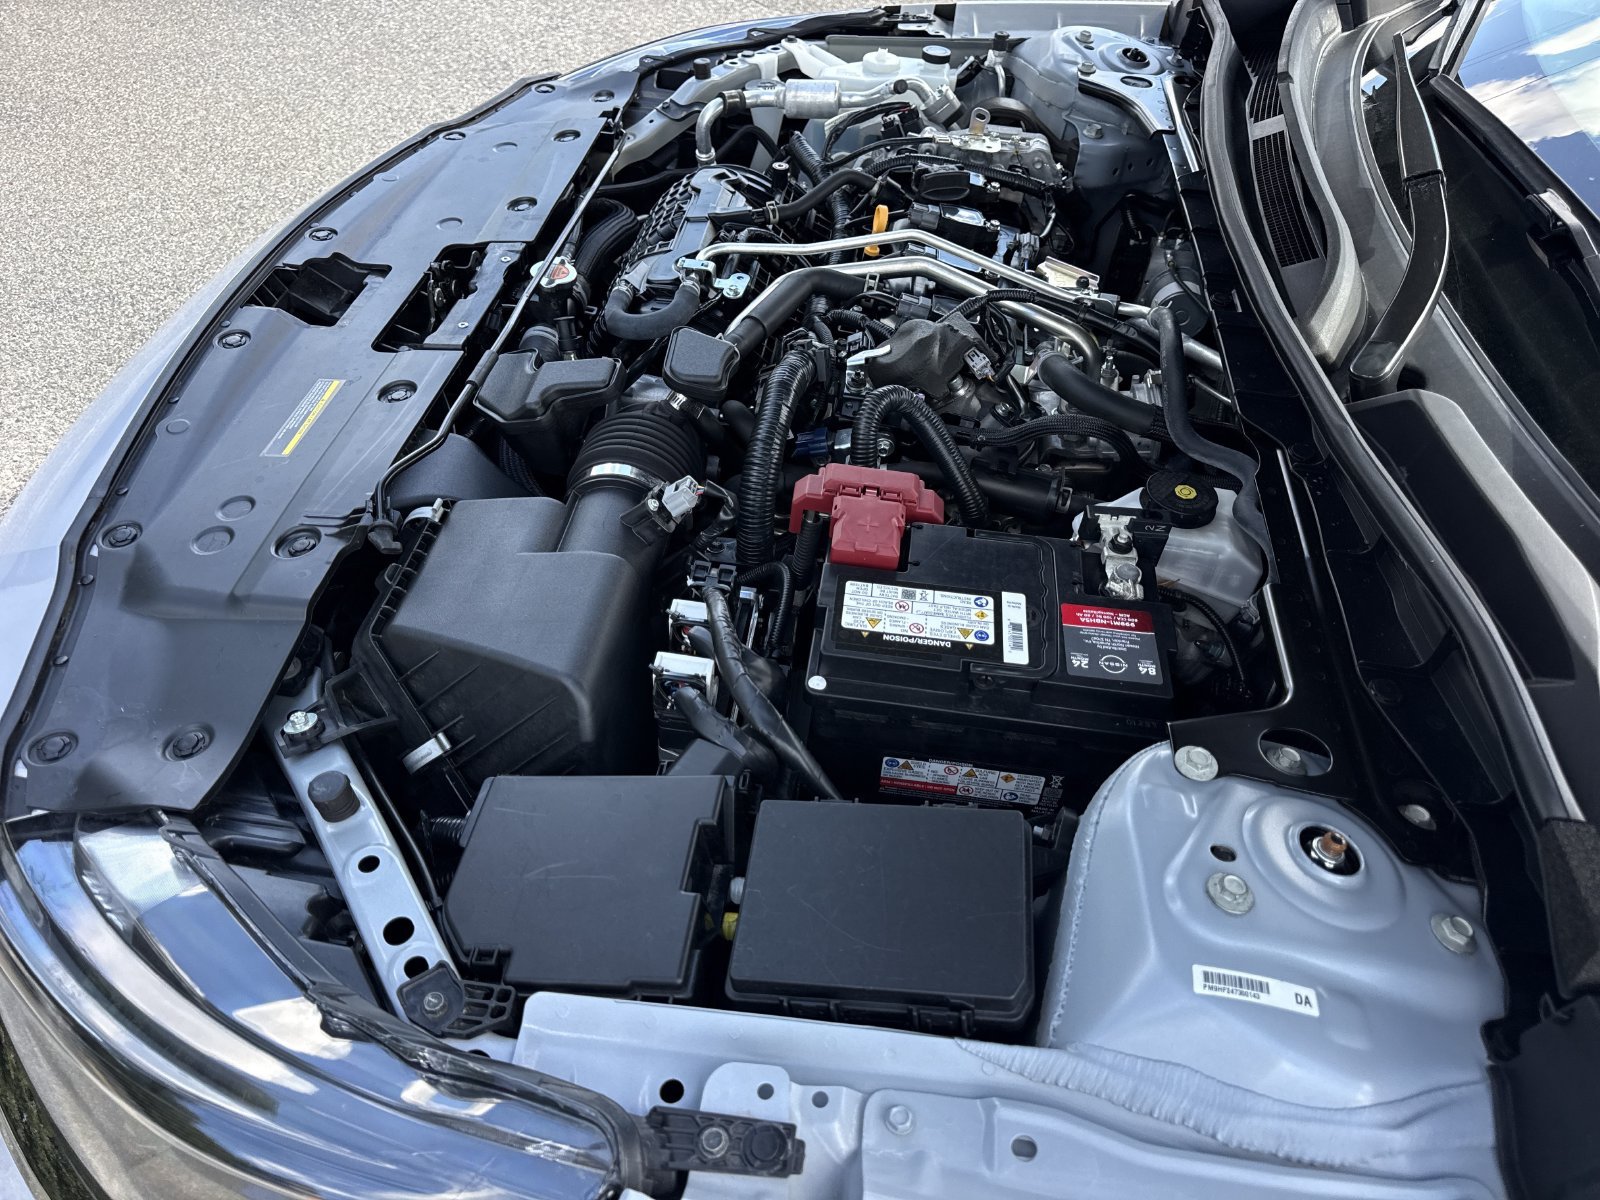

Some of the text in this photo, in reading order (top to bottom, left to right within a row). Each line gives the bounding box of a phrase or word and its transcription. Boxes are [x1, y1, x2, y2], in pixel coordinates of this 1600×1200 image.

[1079, 616, 1135, 627] 999M1-NBH5A
[882, 633, 950, 647] DANGER/POISON
[1071, 659, 1088, 668] 24
[1138, 666, 1156, 675] 84
[1294, 992, 1312, 1008] DA
